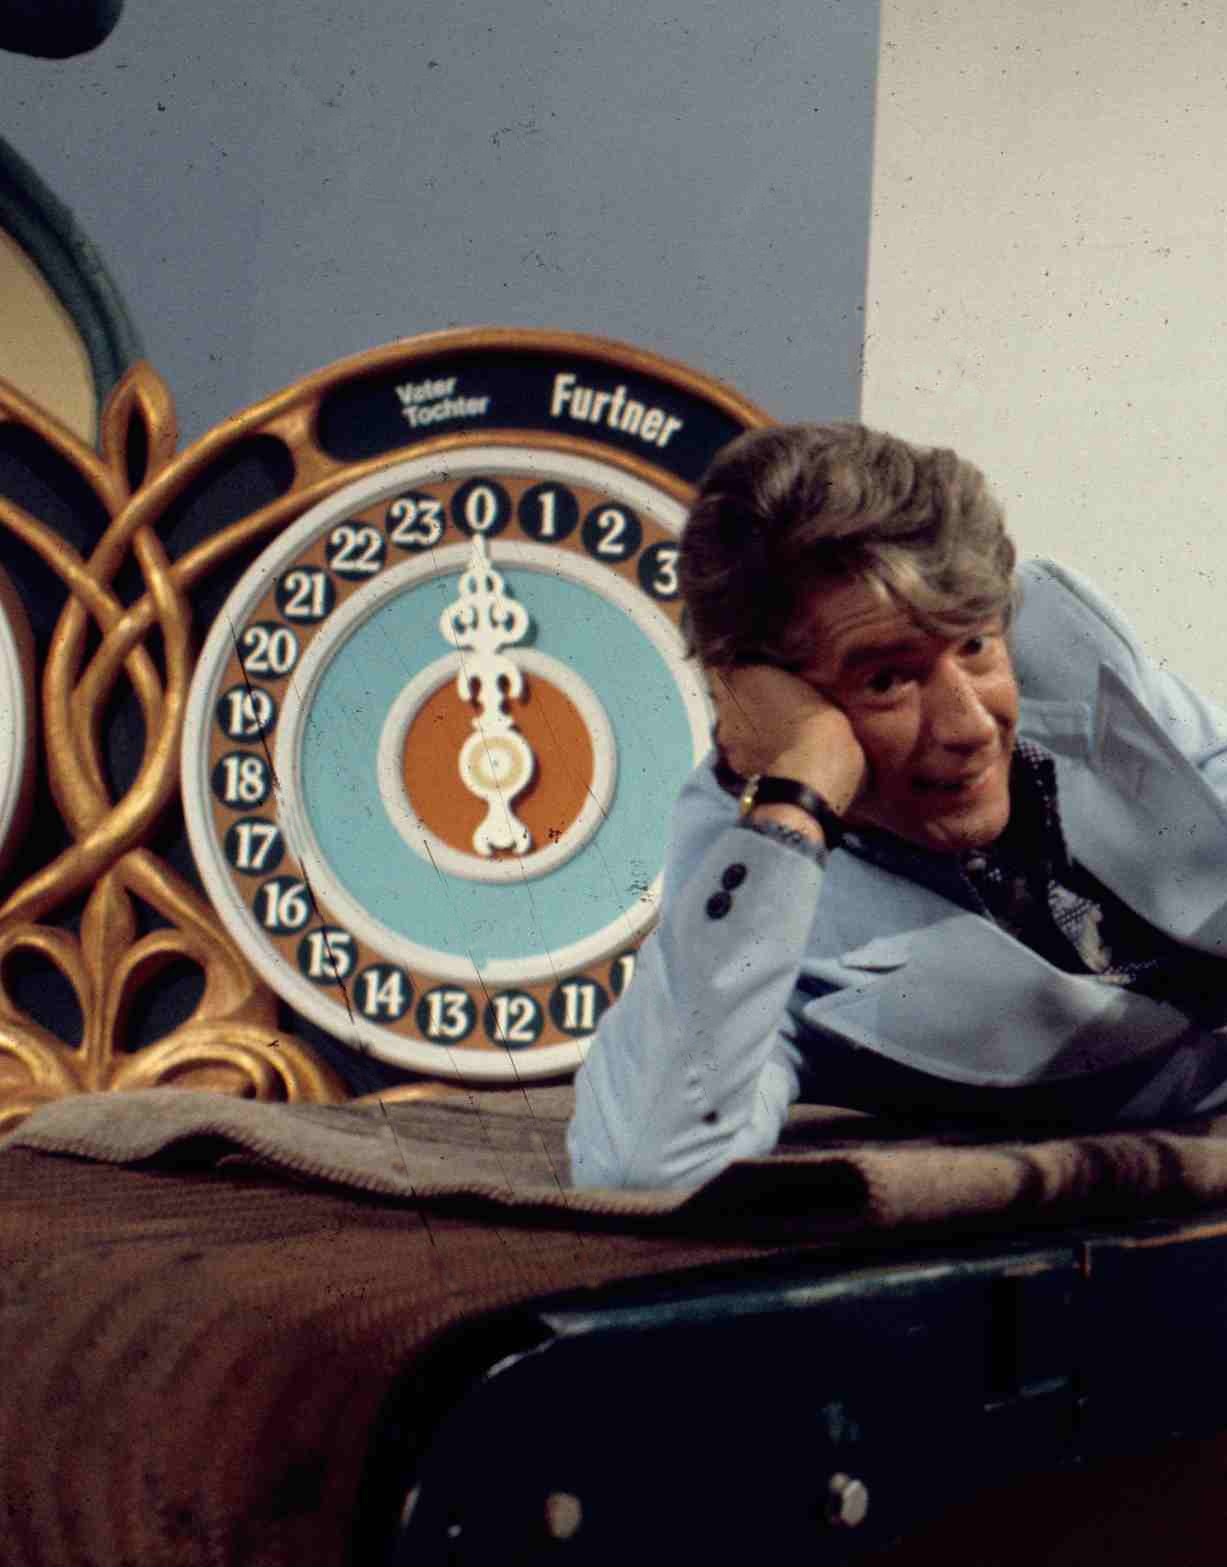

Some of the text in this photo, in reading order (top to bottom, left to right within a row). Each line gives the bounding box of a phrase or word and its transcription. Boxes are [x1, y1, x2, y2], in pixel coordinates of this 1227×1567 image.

[401, 396, 490, 428] Tochter
[551, 373, 683, 447] Furtner
[390, 498, 442, 546] 23
[466, 485, 498, 531] 0
[538, 491, 556, 536] 1
[330, 525, 382, 576] 22
[597, 509, 626, 555] 2
[283, 571, 326, 617] 21
[654, 549, 680, 595] 3
[243, 625, 298, 675] 20
[227, 690, 274, 733] 19
[223, 757, 264, 802] 18
[235, 822, 276, 869] 17
[264, 882, 308, 928] 16
[308, 933, 352, 978] 15
[365, 972, 405, 1018] 14
[427, 992, 469, 1039] 13
[561, 984, 595, 1029] 11
[493, 996, 536, 1043] 12
